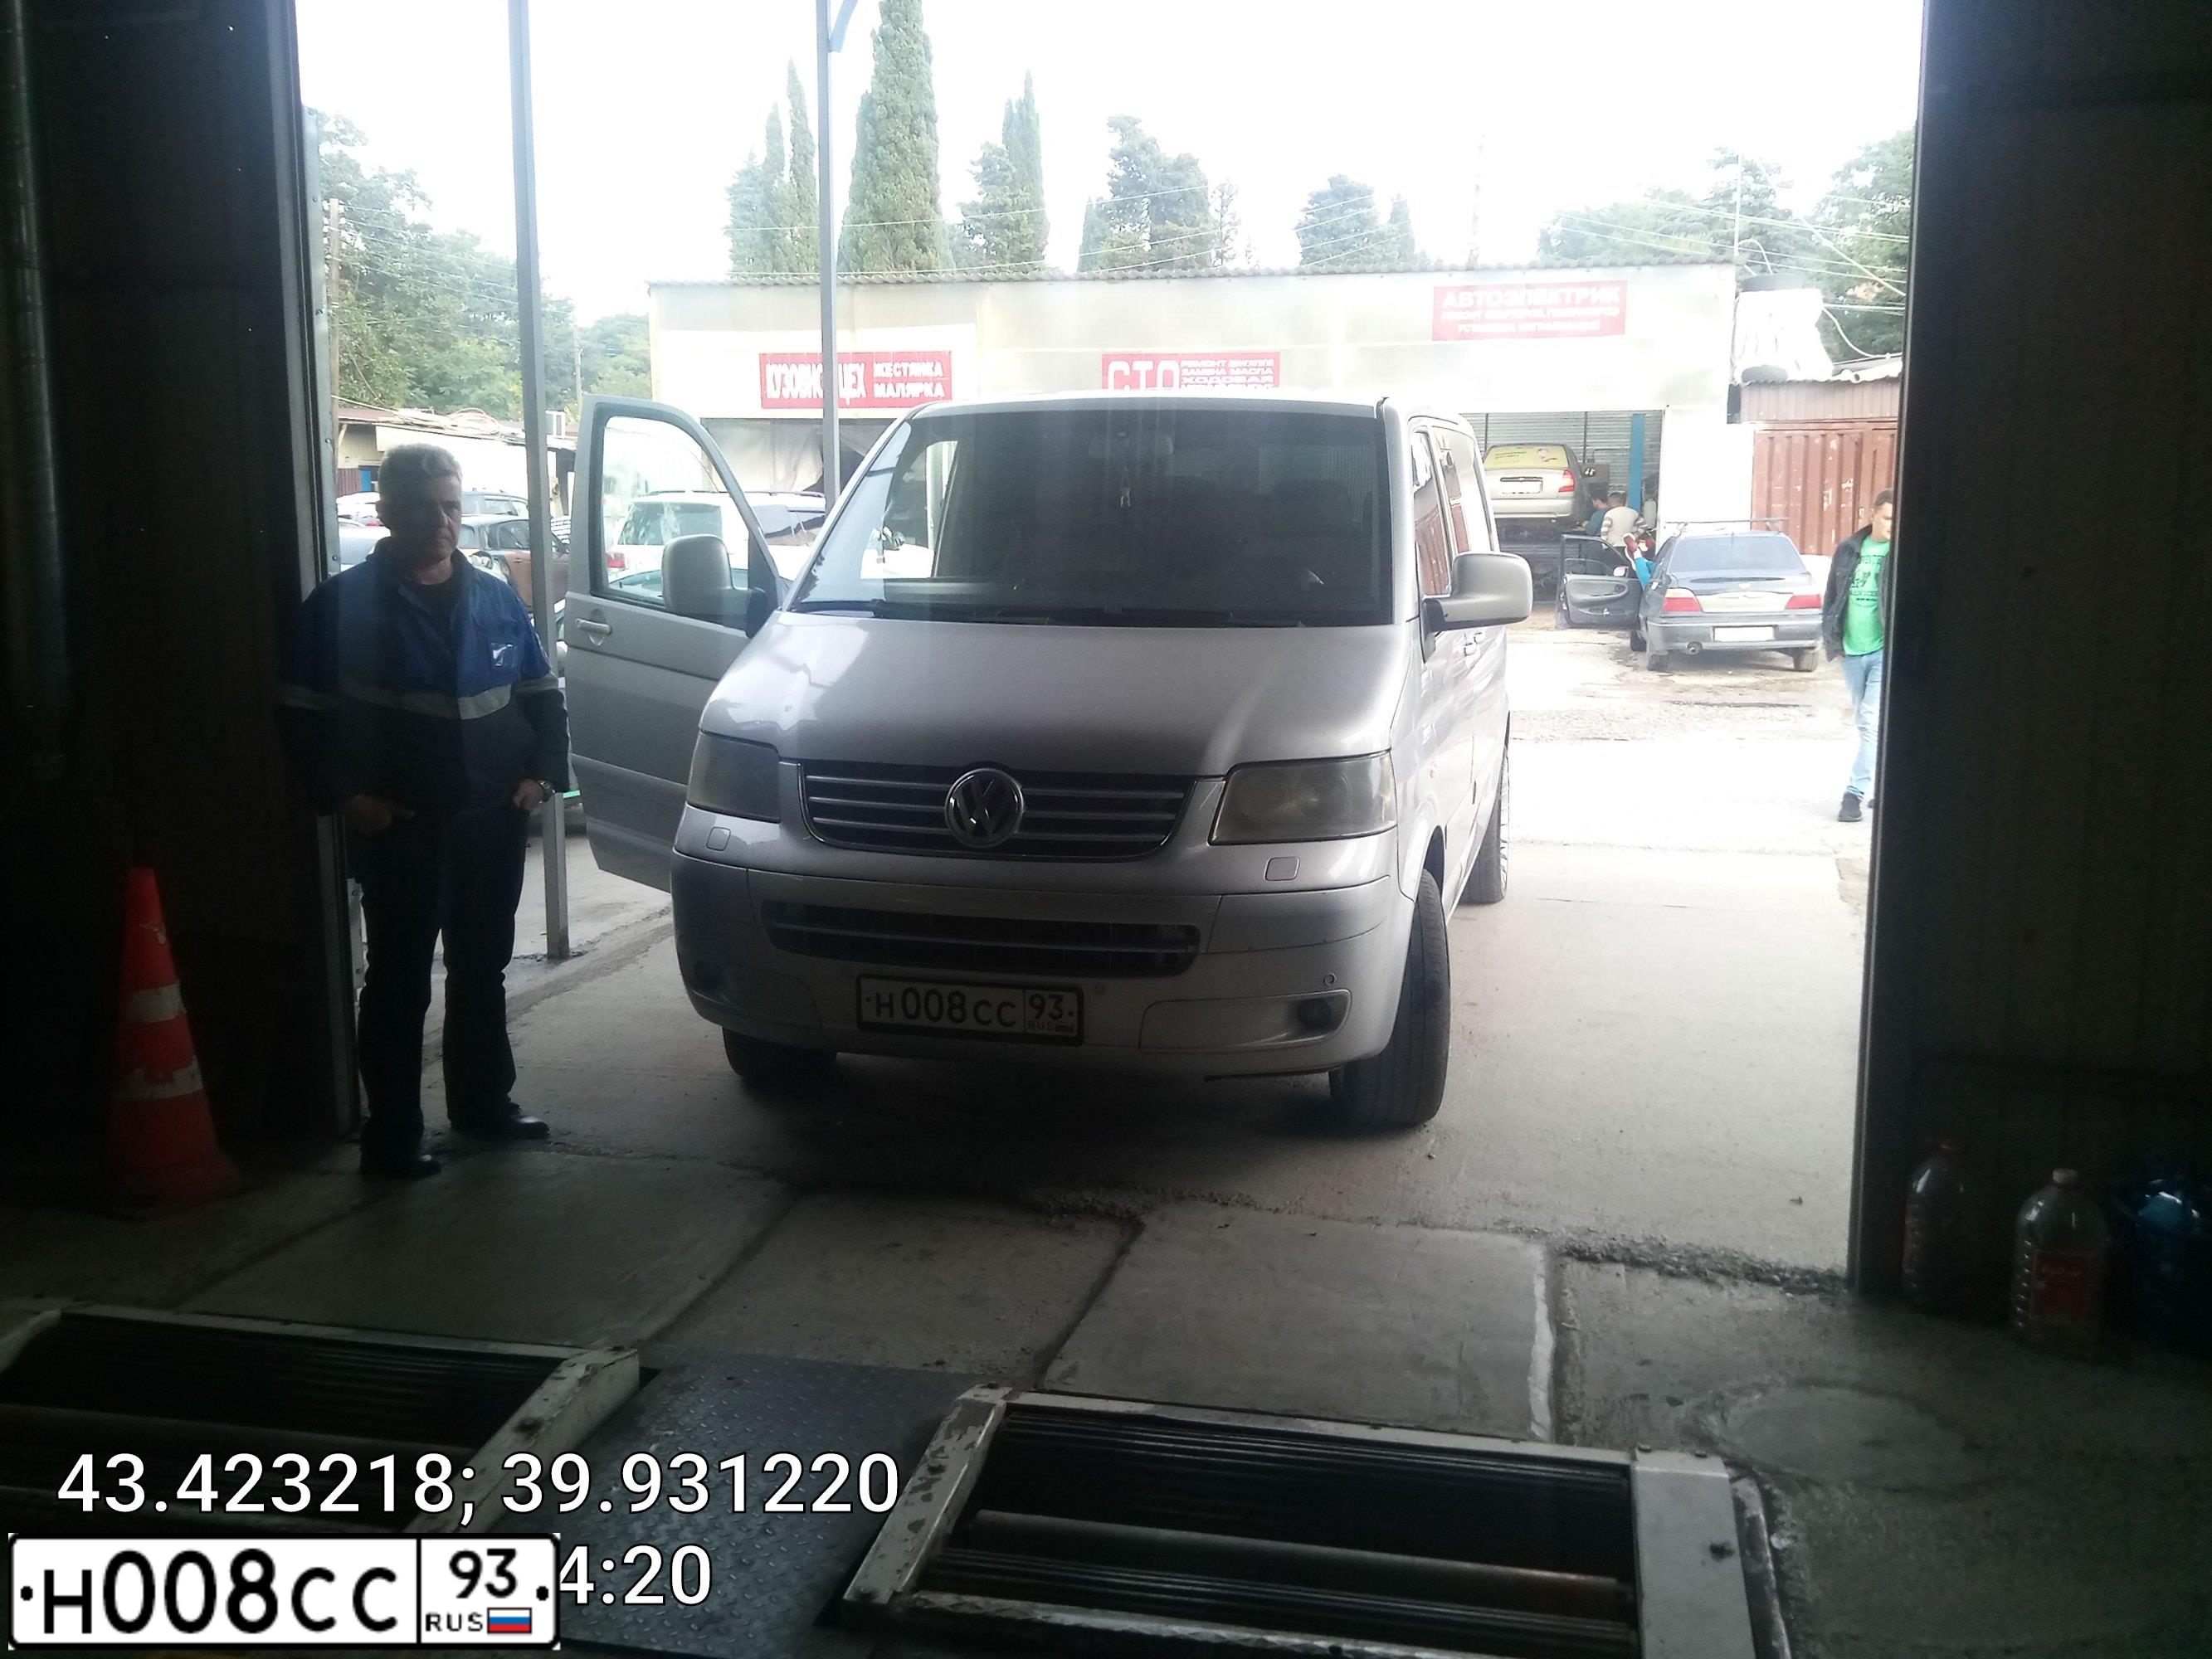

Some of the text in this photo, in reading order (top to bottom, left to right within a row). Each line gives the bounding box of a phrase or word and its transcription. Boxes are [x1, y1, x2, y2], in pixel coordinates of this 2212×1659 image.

[765, 362, 867, 406] КУЗОВНО ЦЕХ
[1108, 359, 1181, 390] СТО
[874, 382, 945, 398] МАЛЯРКА
[1028, 994, 1064, 1020] 93
